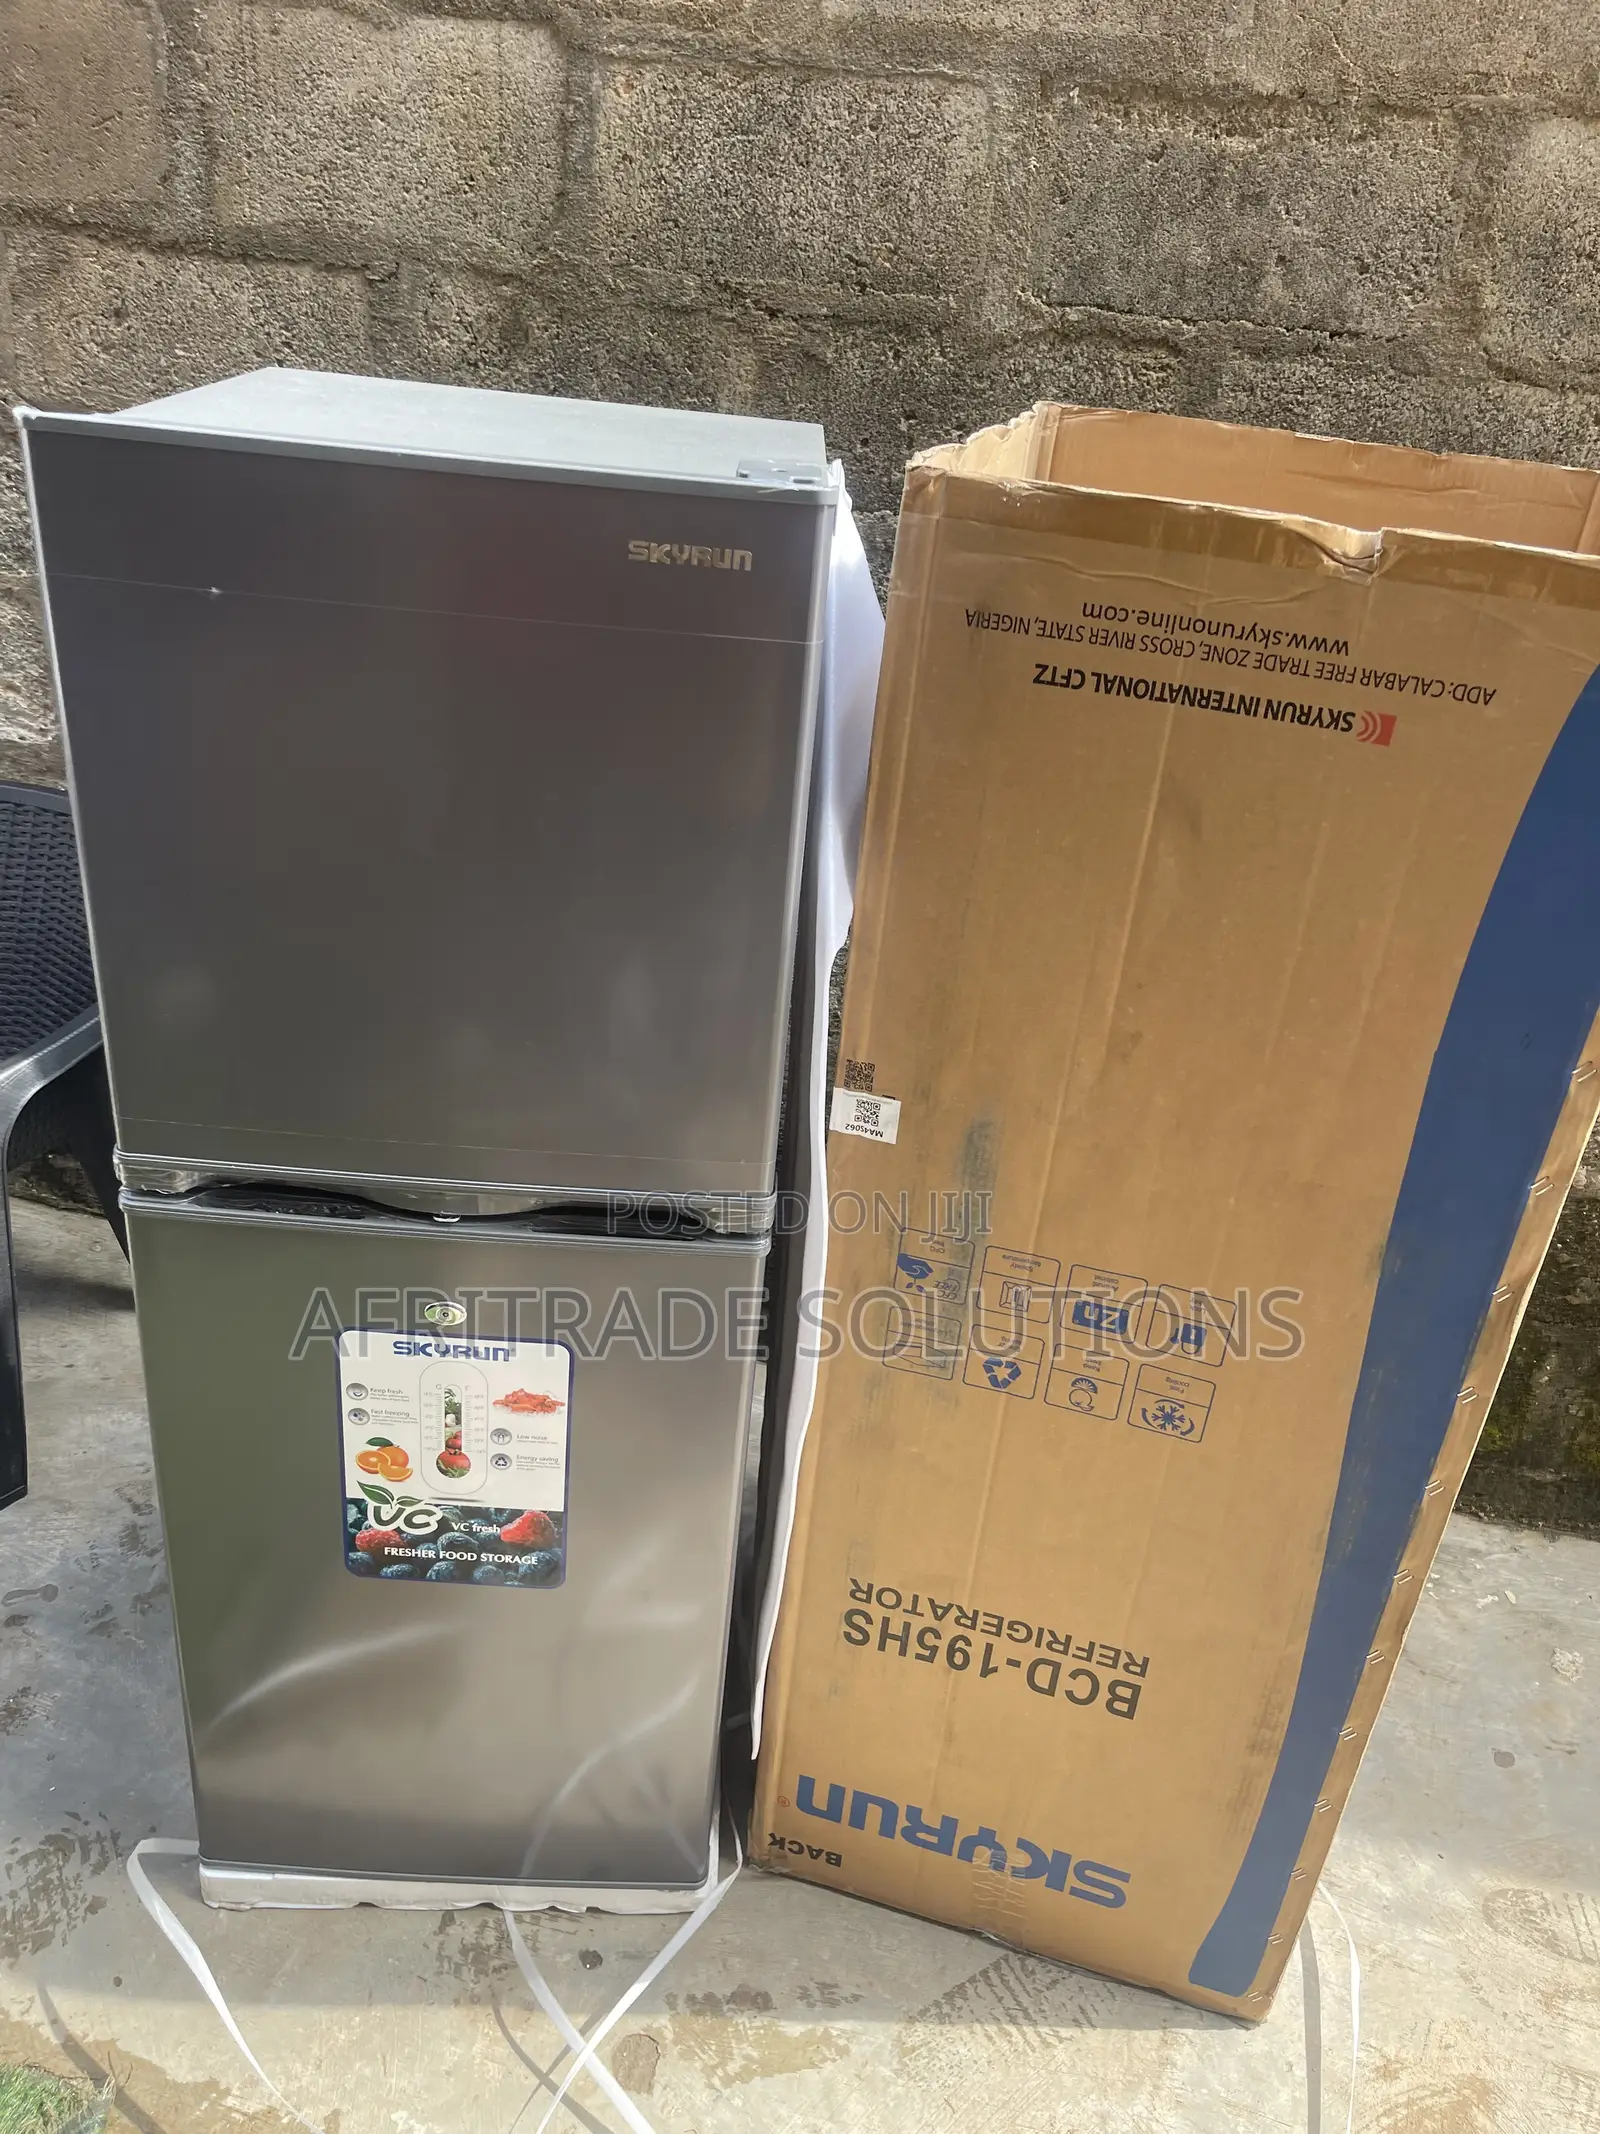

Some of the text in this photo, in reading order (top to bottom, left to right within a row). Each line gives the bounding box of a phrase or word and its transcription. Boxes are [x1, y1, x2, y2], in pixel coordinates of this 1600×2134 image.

[627, 539, 753, 573] SKYRUN
[1081, 602, 1349, 656] www.skyrunonline.com
[965, 608, 1497, 706] ADD: CALABAR FREE TRADE ZONE, CROSS RIVER STATE, NIGERIA
[1032, 663, 1357, 732] SKYRUN INTERNATIONAL CFTZ
[1083, 1304, 1120, 1330] Zn
[393, 1340, 510, 1362] SKYRUN
[370, 1387, 404, 1395] Keep fresh
[384, 1409, 410, 1417] freezing
[516, 1454, 538, 1462] Energy
[451, 1523, 500, 1533] VC fresh
[384, 1546, 539, 1566] FRESHER FOOD STORAGE
[848, 1577, 1150, 1679] REFRIGERATOR
[843, 1607, 1143, 1721] BCD-195HS
[766, 1832, 843, 1868] BACK
[795, 1774, 1132, 1909] SKYRUN
